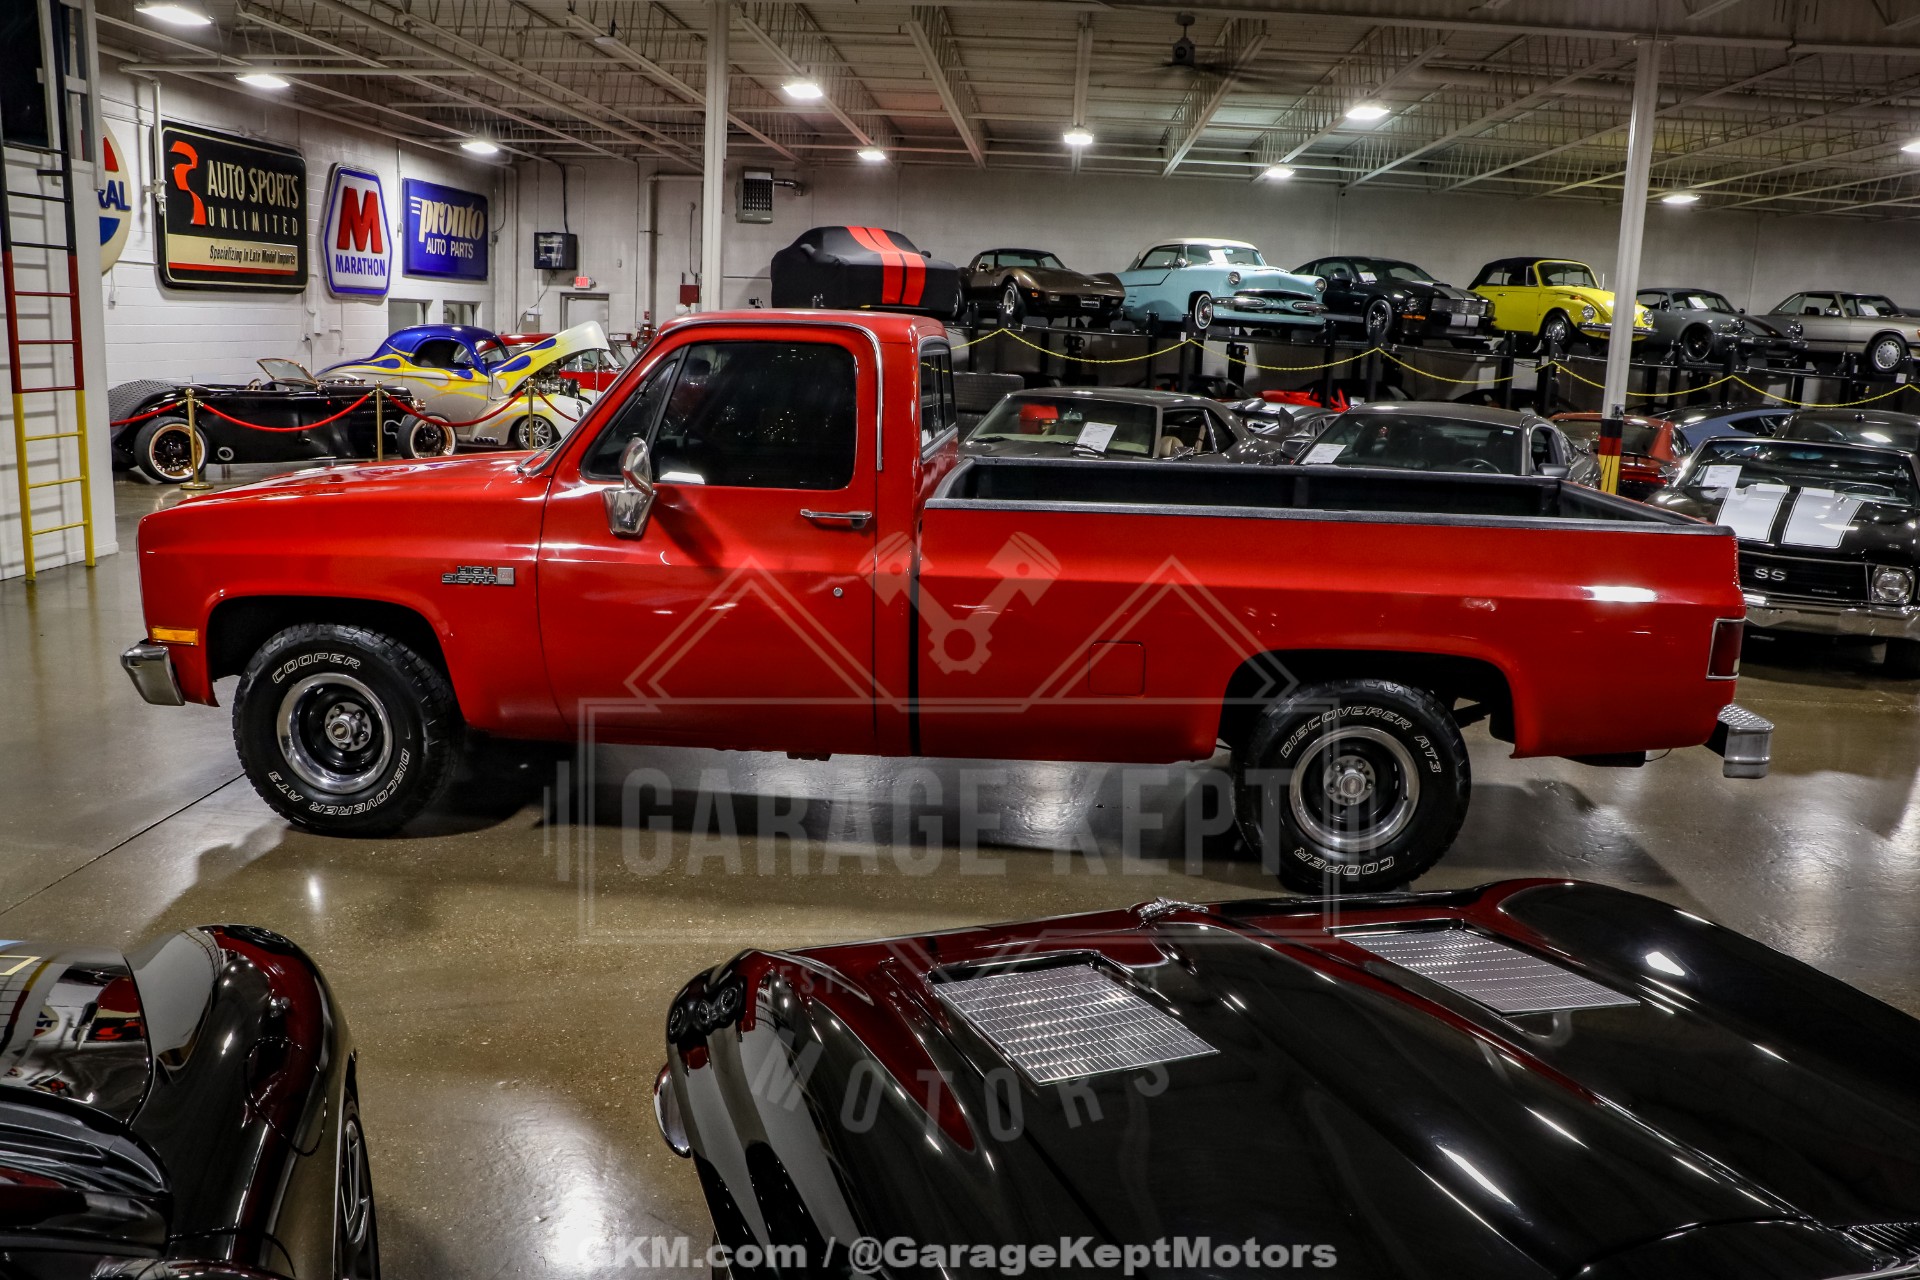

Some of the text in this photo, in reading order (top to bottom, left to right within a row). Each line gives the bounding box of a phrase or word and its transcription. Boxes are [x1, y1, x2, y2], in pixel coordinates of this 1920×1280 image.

[207, 160, 299, 209] AUTO SPORTS
[207, 206, 298, 236] UNLIMITED
[337, 186, 383, 254] M
[418, 198, 485, 243] pronto
[209, 245, 243, 263] Specializing
[249, 248, 261, 262] Late
[261, 249, 277, 264] Model
[425, 238, 474, 259] AUTO PARTS
[335, 254, 386, 277] MARATHON
[442, 573, 498, 584] SIERRA
[457, 566, 493, 575] HIGH
[1754, 567, 1786, 581] SS
[272, 652, 361, 684] COOPER
[1280, 705, 1442, 773] DISCOVERER AT3
[268, 748, 410, 816] DISCOVERER AT3
[1295, 847, 1395, 876] COOPER
